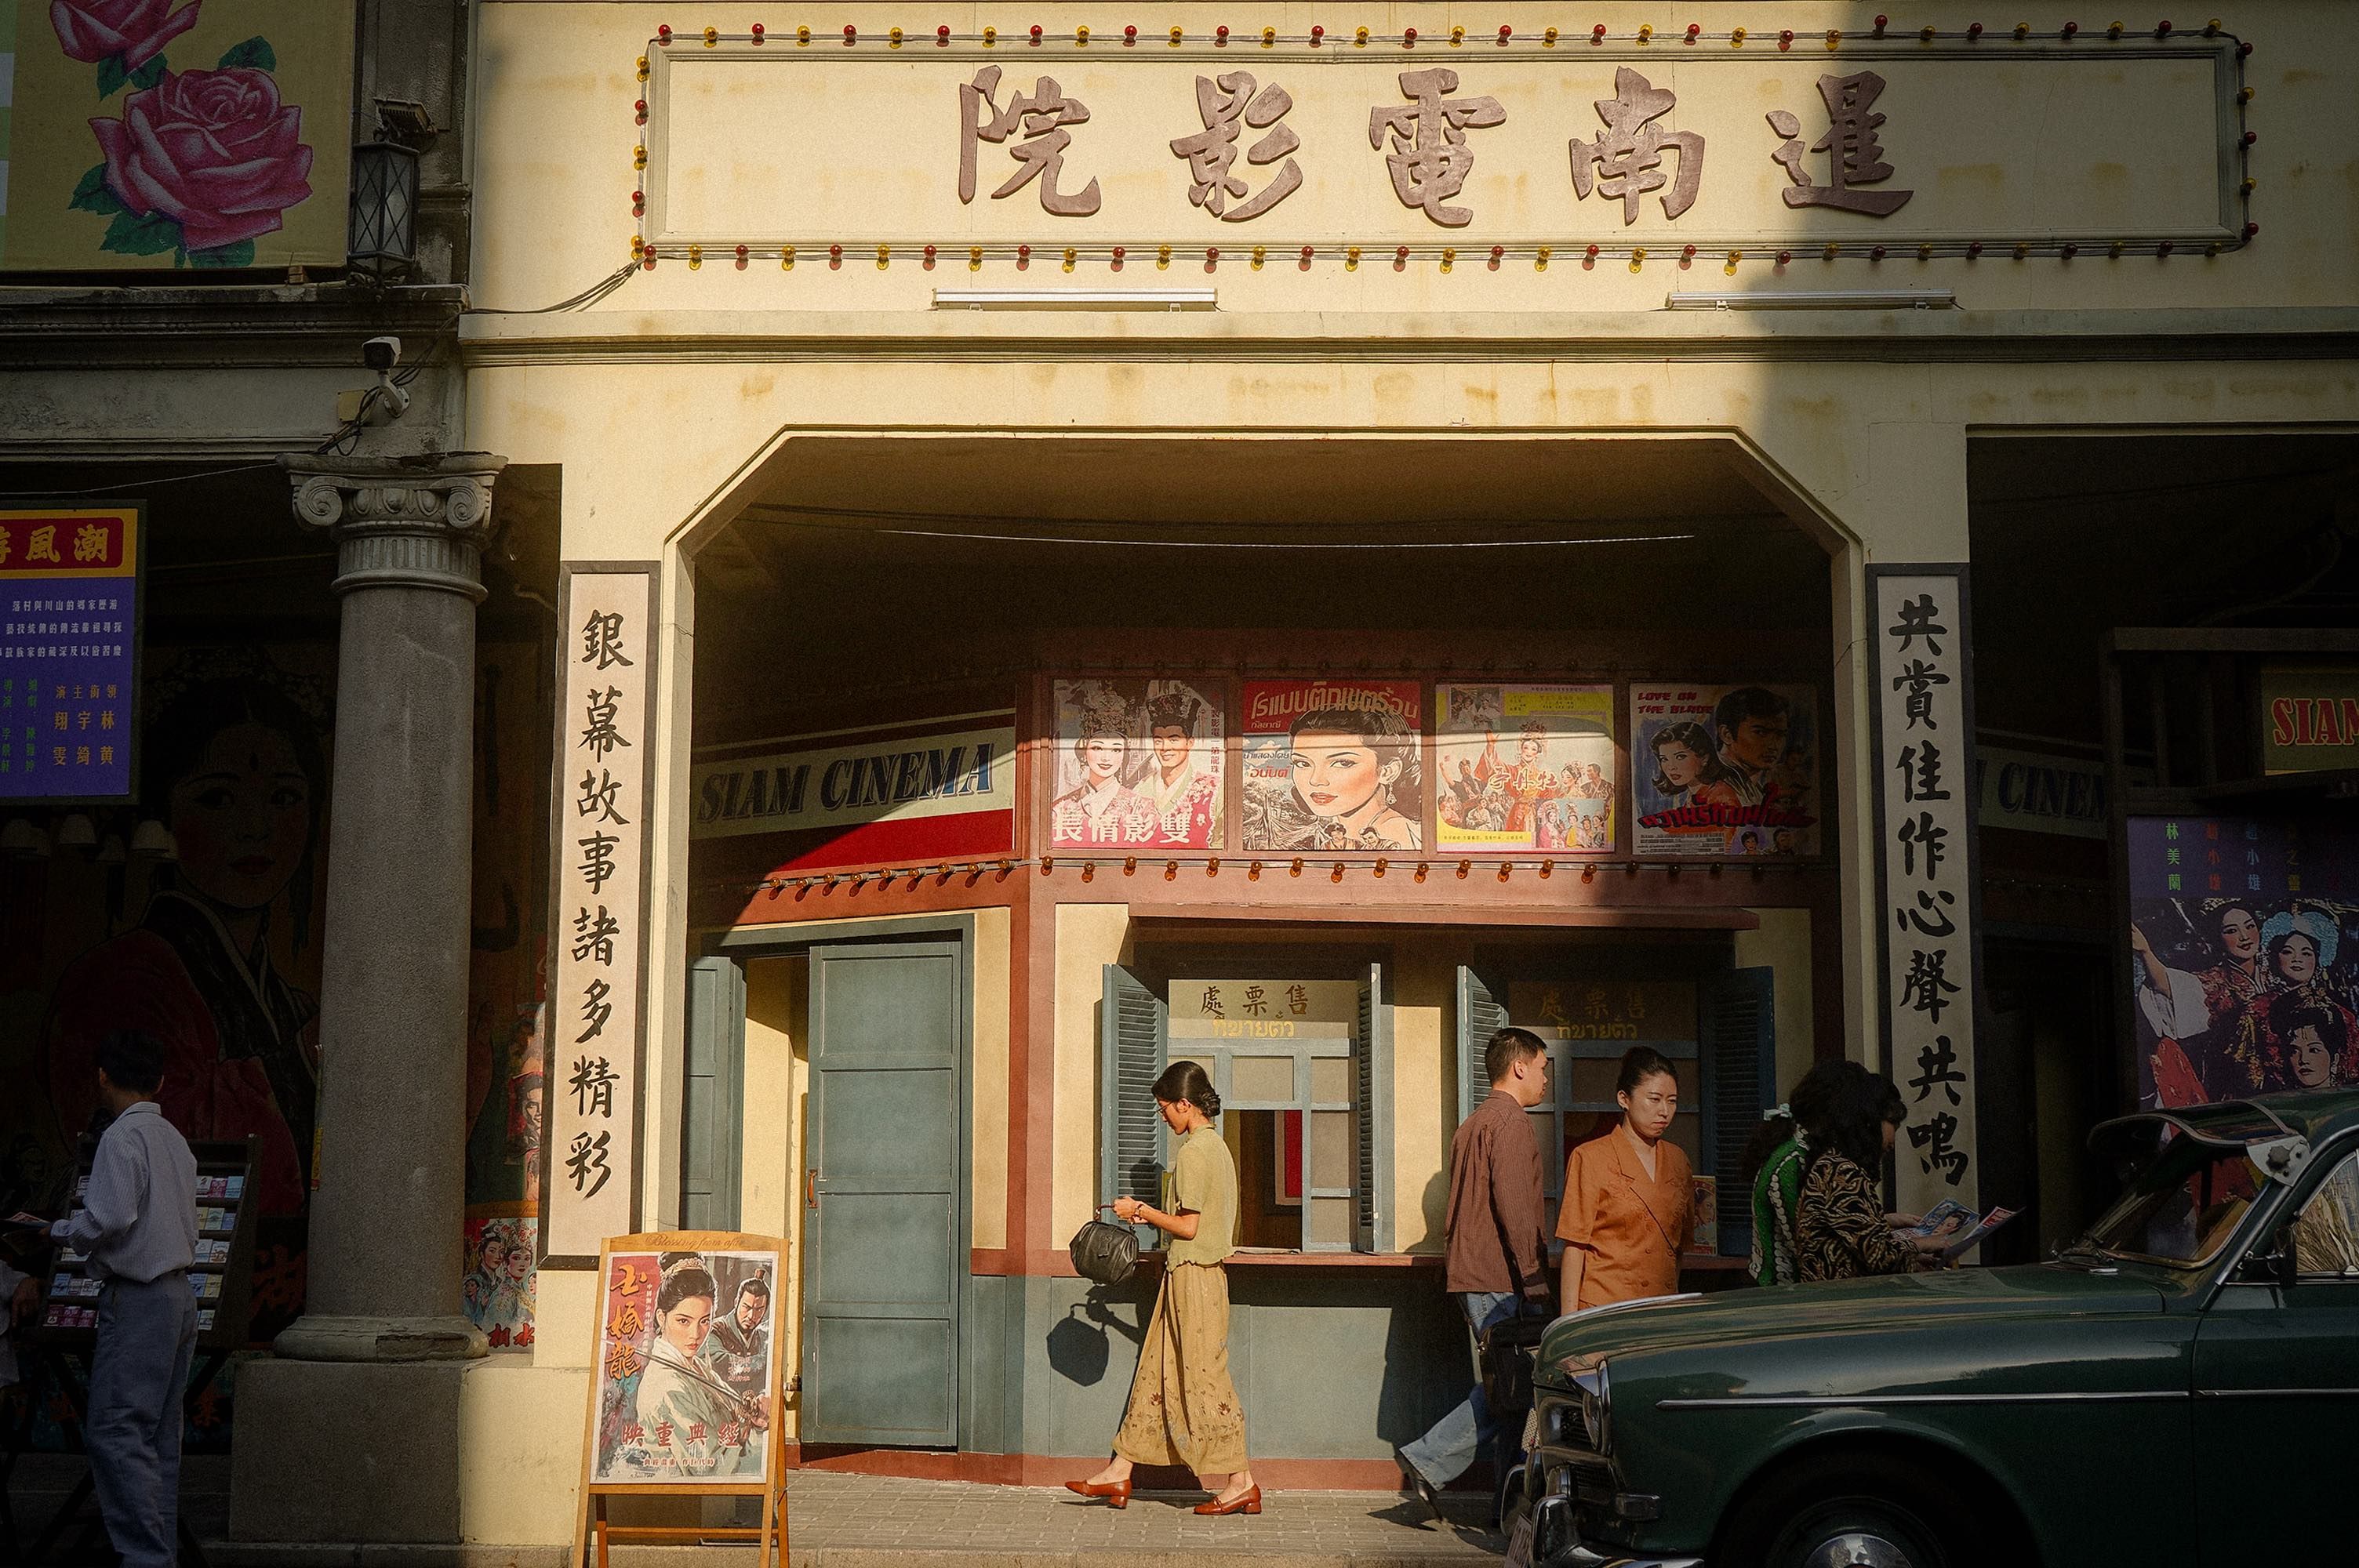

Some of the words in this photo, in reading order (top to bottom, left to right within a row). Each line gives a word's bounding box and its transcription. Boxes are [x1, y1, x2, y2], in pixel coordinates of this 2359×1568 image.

[565, 608, 634, 1200] 銀幕故事諸多精彩
[697, 764, 811, 823] SIAM
[820, 742, 994, 811] CINEMA
[1888, 593, 1968, 1185] 共賞佳作心聲共鳴
[1200, 985, 1308, 1017] 售票處
